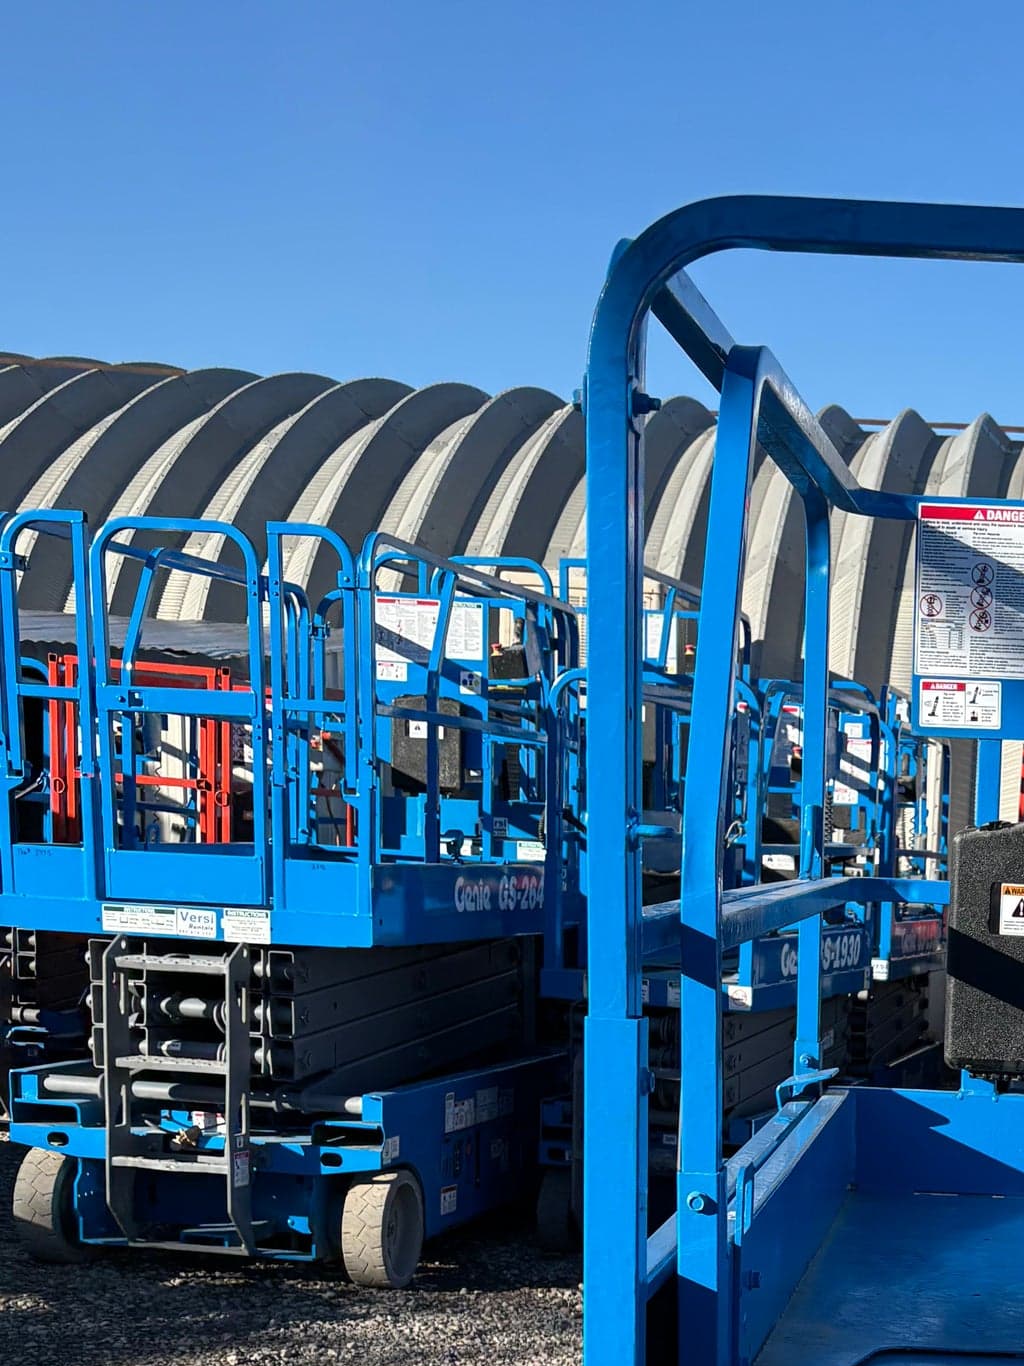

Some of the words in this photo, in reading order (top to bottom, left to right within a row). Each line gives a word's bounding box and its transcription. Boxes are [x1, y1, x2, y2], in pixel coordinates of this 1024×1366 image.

[454, 876, 491, 912] Genie
[498, 875, 545, 910] GS-264
[180, 911, 214, 925] Versi
[821, 934, 861, 970] S-1930
